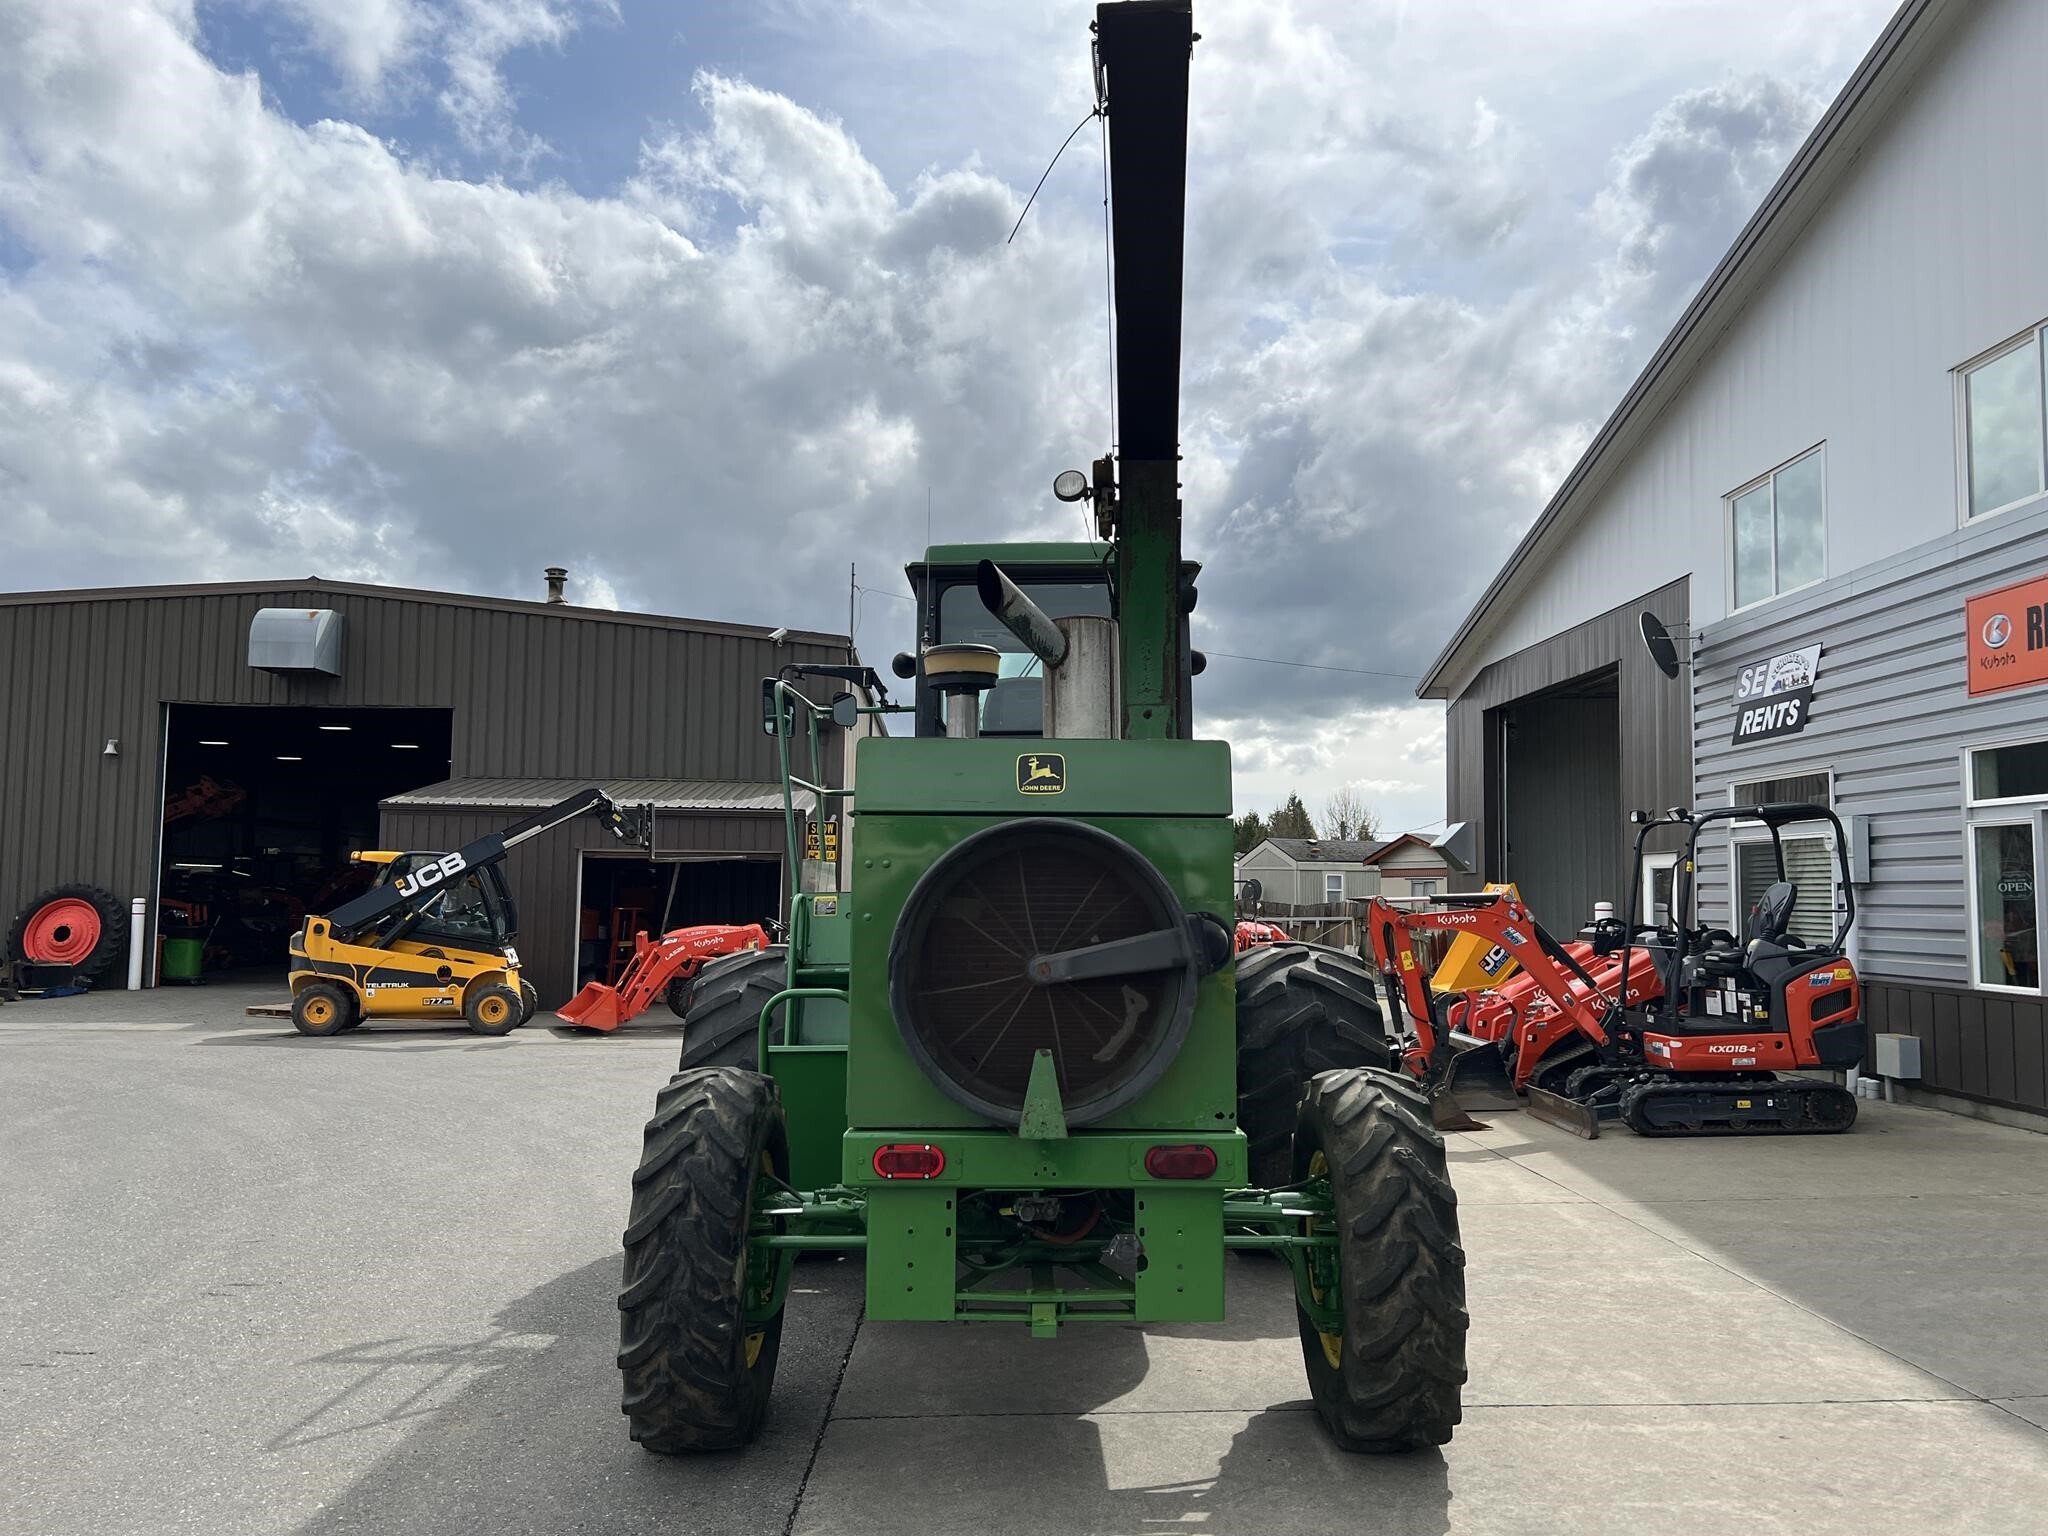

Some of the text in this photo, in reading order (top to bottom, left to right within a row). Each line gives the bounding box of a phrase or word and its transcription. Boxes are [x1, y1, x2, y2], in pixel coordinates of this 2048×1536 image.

[2027, 603, 2048, 651] R
[1980, 653, 2016, 669] Kubota
[1738, 664, 1768, 698] SE
[1739, 699, 1800, 736] RENTS
[399, 852, 467, 897] JCB
[1998, 882, 2032, 892] OPEN
[1437, 914, 1477, 924] Kubota
[694, 937, 724, 948] Kubota
[1485, 944, 1506, 972] JC
